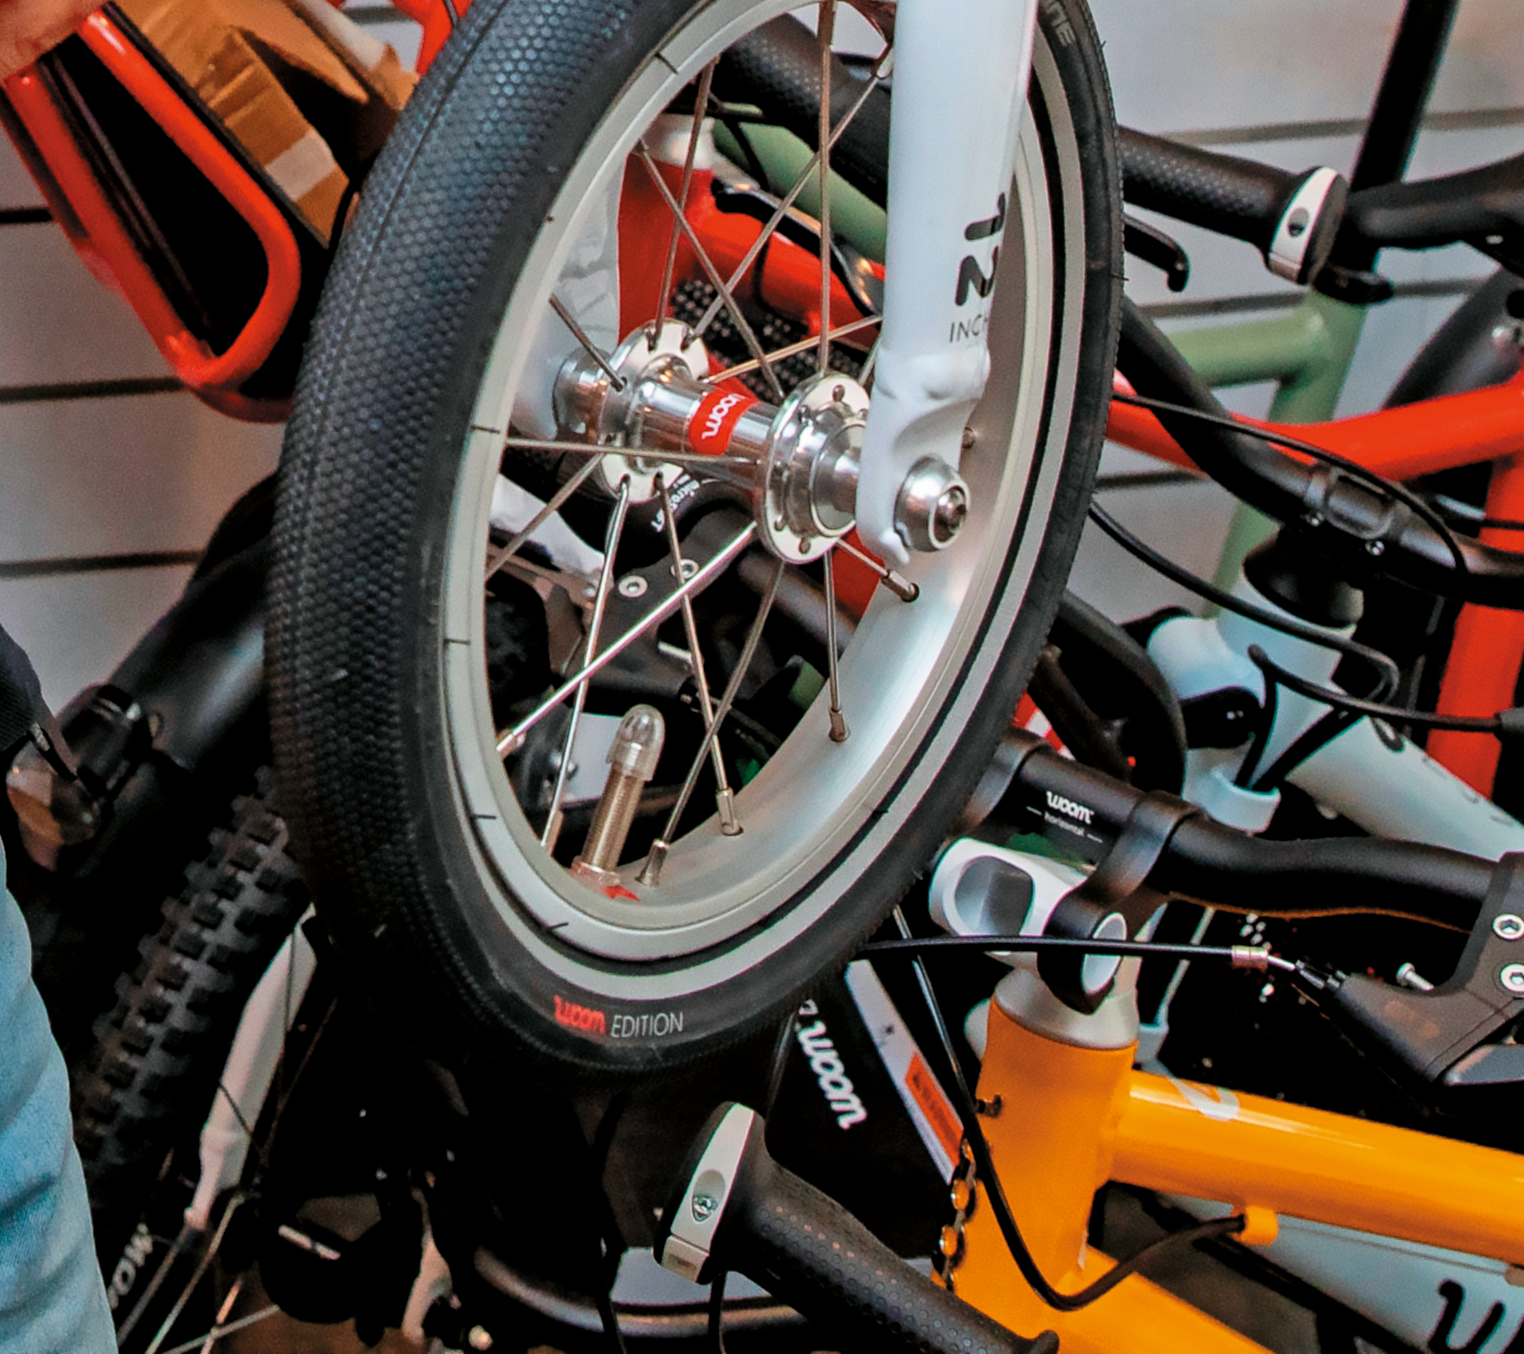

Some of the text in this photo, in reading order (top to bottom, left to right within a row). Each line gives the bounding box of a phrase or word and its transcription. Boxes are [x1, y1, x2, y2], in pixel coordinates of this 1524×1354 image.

[949, 312, 988, 343] INC
[701, 392, 747, 440] woom
[1046, 790, 1092, 825] woom
[553, 994, 684, 1038] woom EDITION
[797, 1019, 868, 1130] woom
